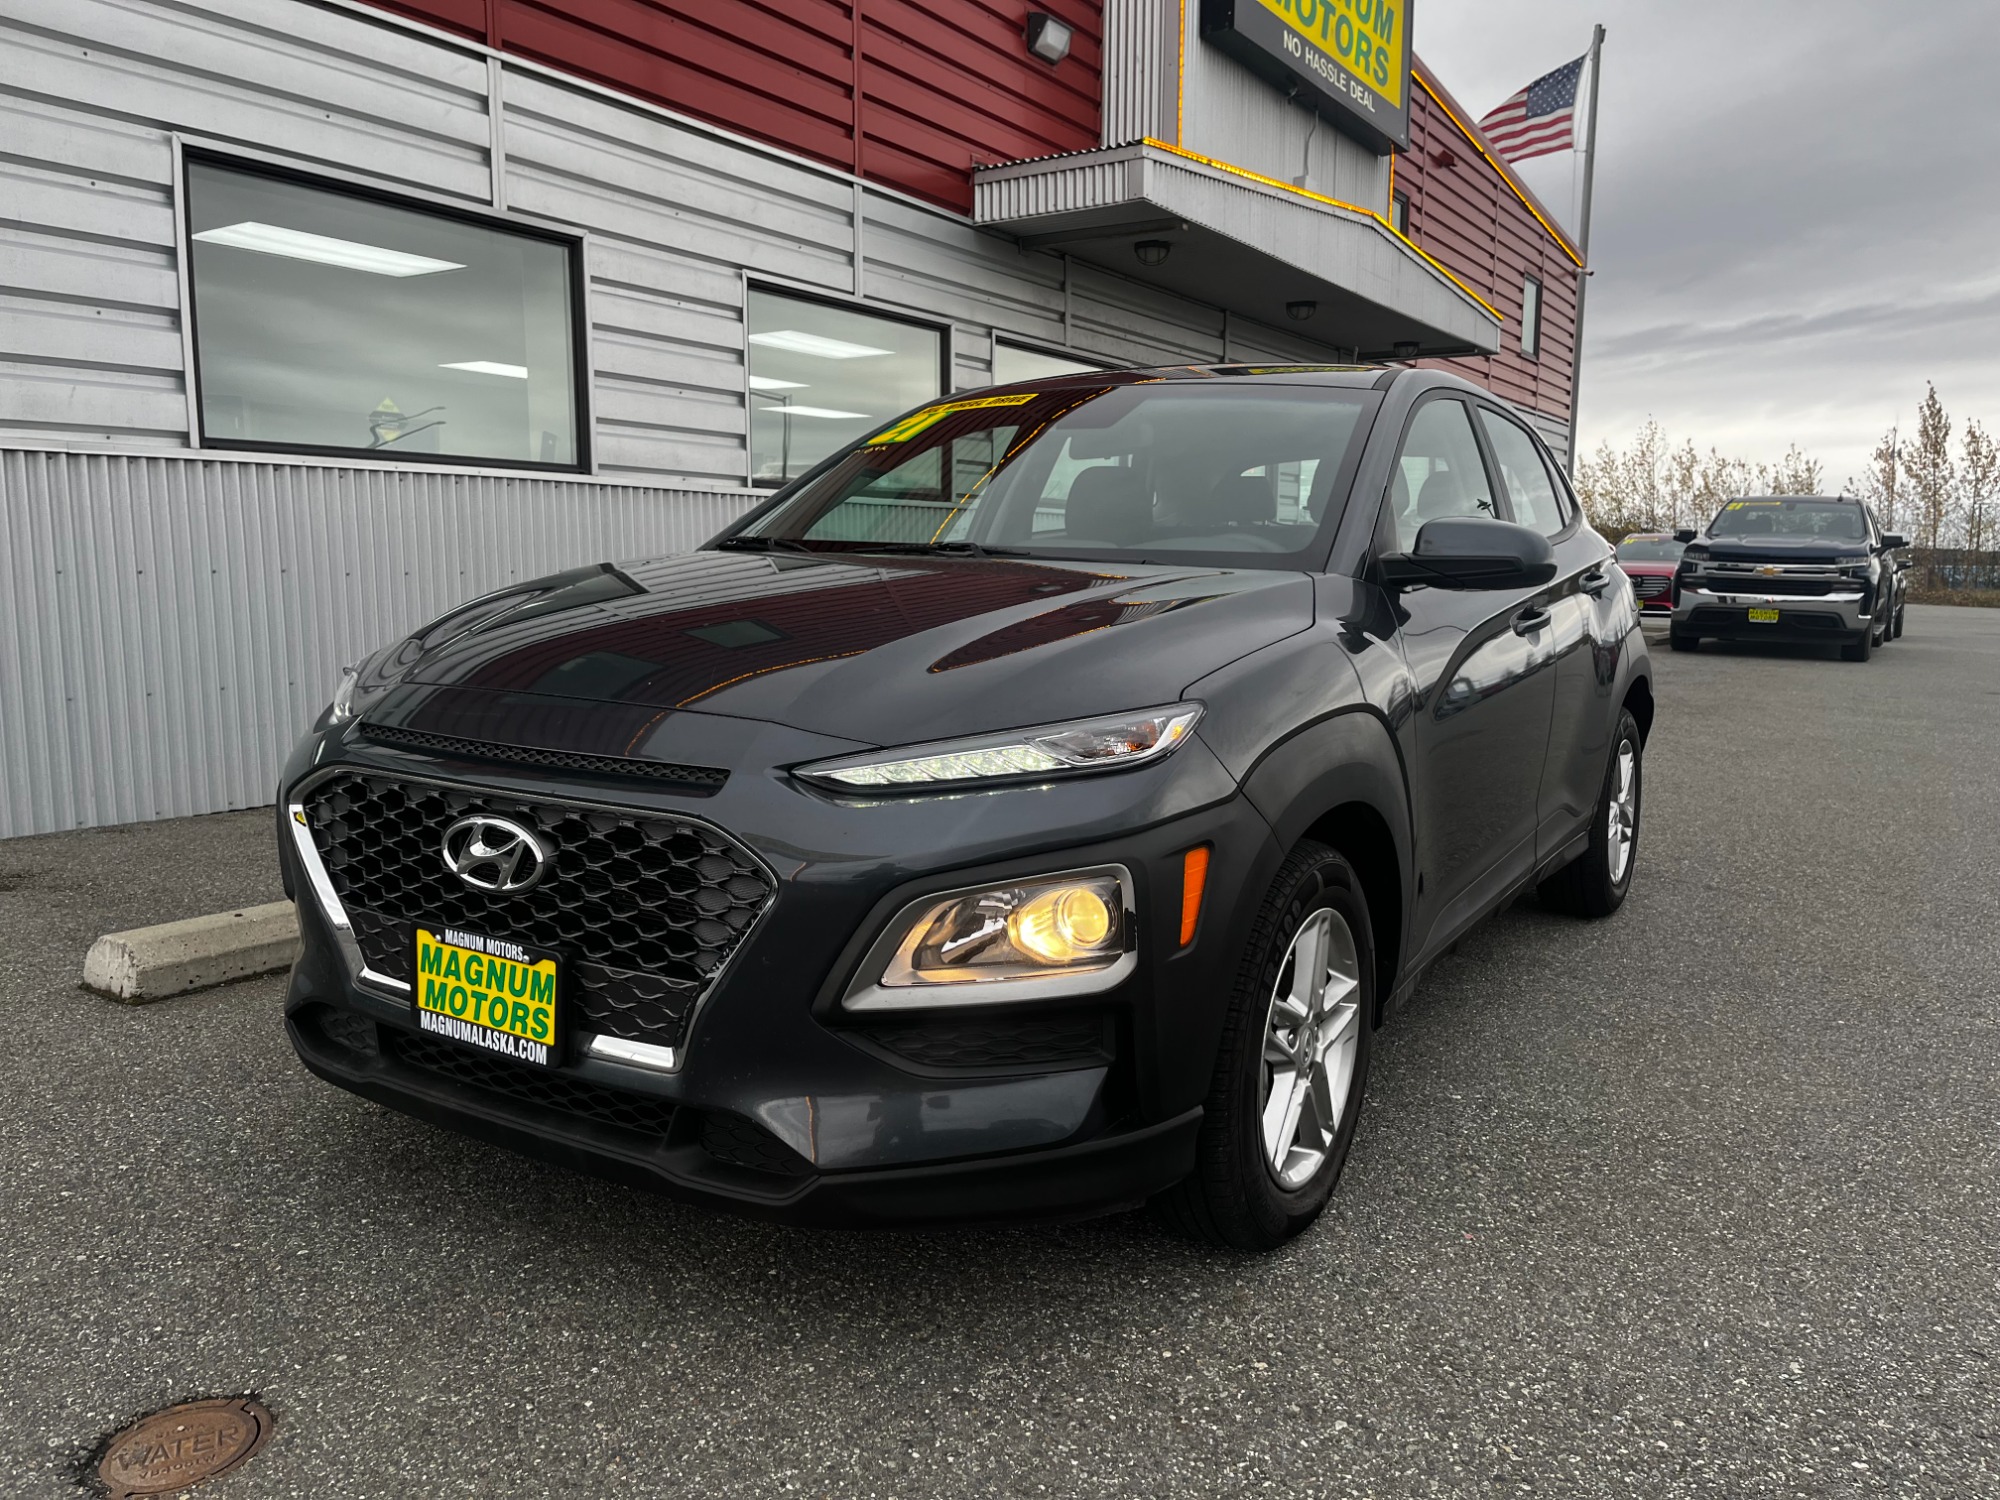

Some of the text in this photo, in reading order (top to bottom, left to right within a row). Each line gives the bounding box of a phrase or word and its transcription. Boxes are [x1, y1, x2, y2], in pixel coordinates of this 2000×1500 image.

[1275, 0, 1391, 87] OTORS
[1283, 30, 1376, 113] NO HASSLE DEAL
[420, 943, 554, 1005] MAGNUM
[445, 928, 523, 962] MAGNUM MOTORS
[420, 1010, 547, 1065] MAGNUMALASKA.COM
[425, 978, 549, 1039] MOTORS
[113, 1425, 239, 1472] WATER
